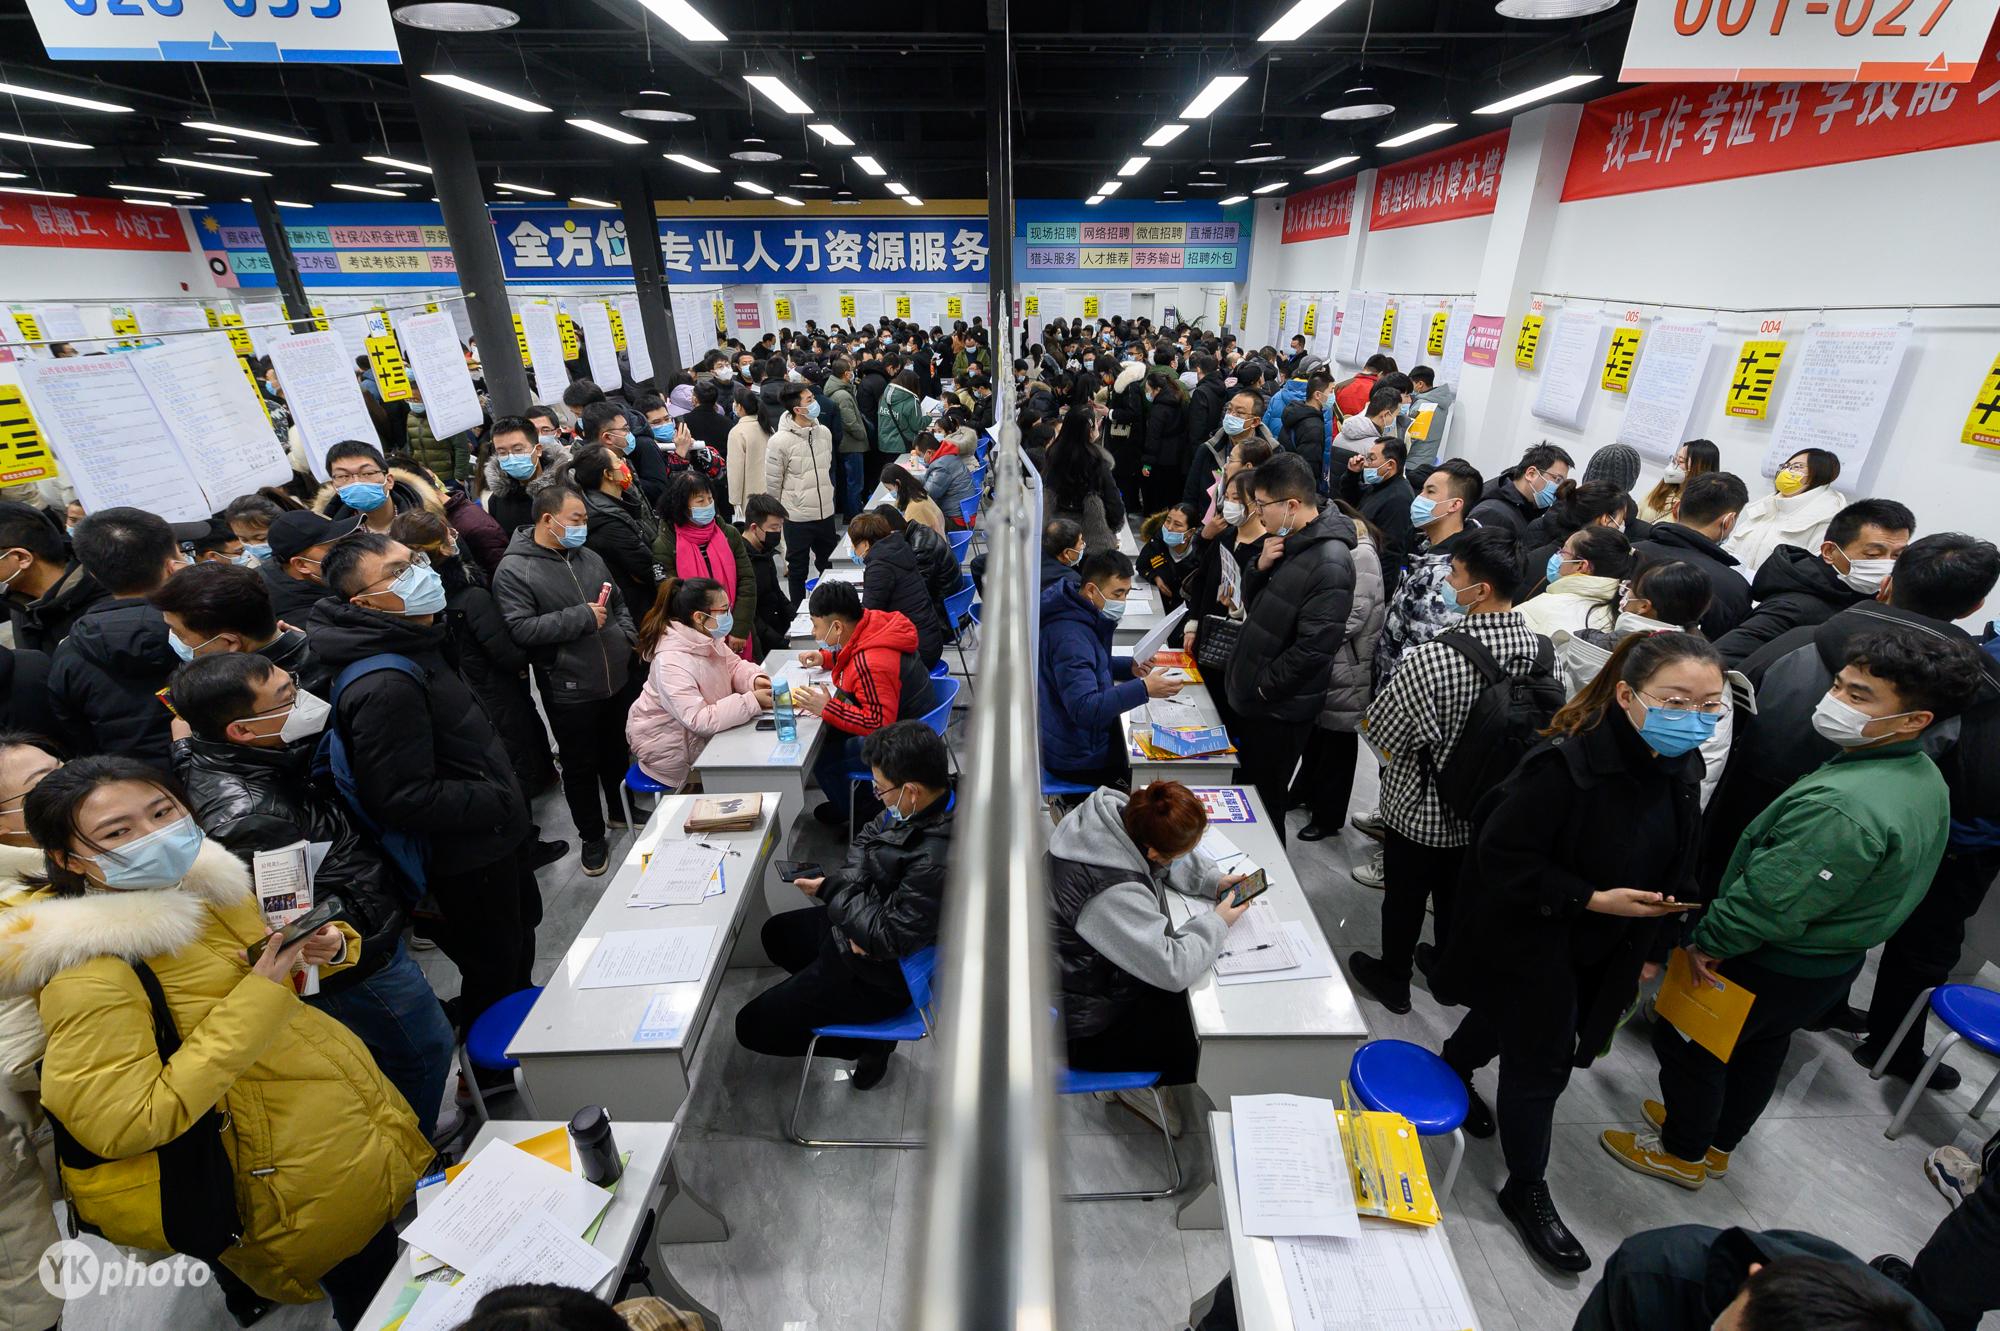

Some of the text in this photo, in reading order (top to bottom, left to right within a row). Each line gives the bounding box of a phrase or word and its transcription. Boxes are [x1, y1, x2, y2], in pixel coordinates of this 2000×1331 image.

[1673, 0, 1945, 37] 001-027
[1602, 94, 1694, 172] 找工作
[1694, 82, 1801, 156] 考证书
[1379, 147, 1507, 217] 帮组织减负降本增
[335, 230, 421, 244] 社保公积金代理
[1030, 226, 1236, 240] 现场招聘 网络招聘 微信招聘 直播招聘
[658, 228, 990, 274] 专业人力资源服务
[1030, 251, 1233, 265] 猎头服务 人才推荐 劳务输出 招聘外包
[1532, 300, 1544, 311] 006
[369, 319, 385, 331] 048
[1625, 311, 1640, 322] 005
[1522, 321, 1541, 338] 十二
[1760, 320, 1783, 334] 004
[371, 345, 400, 365] 十二
[1517, 340, 1536, 357] 十三
[1612, 336, 1639, 356] 十二
[1606, 358, 1632, 378] 十三
[1740, 351, 1781, 374] 十二
[379, 367, 406, 387] 十三
[1732, 377, 1772, 401] 十三
